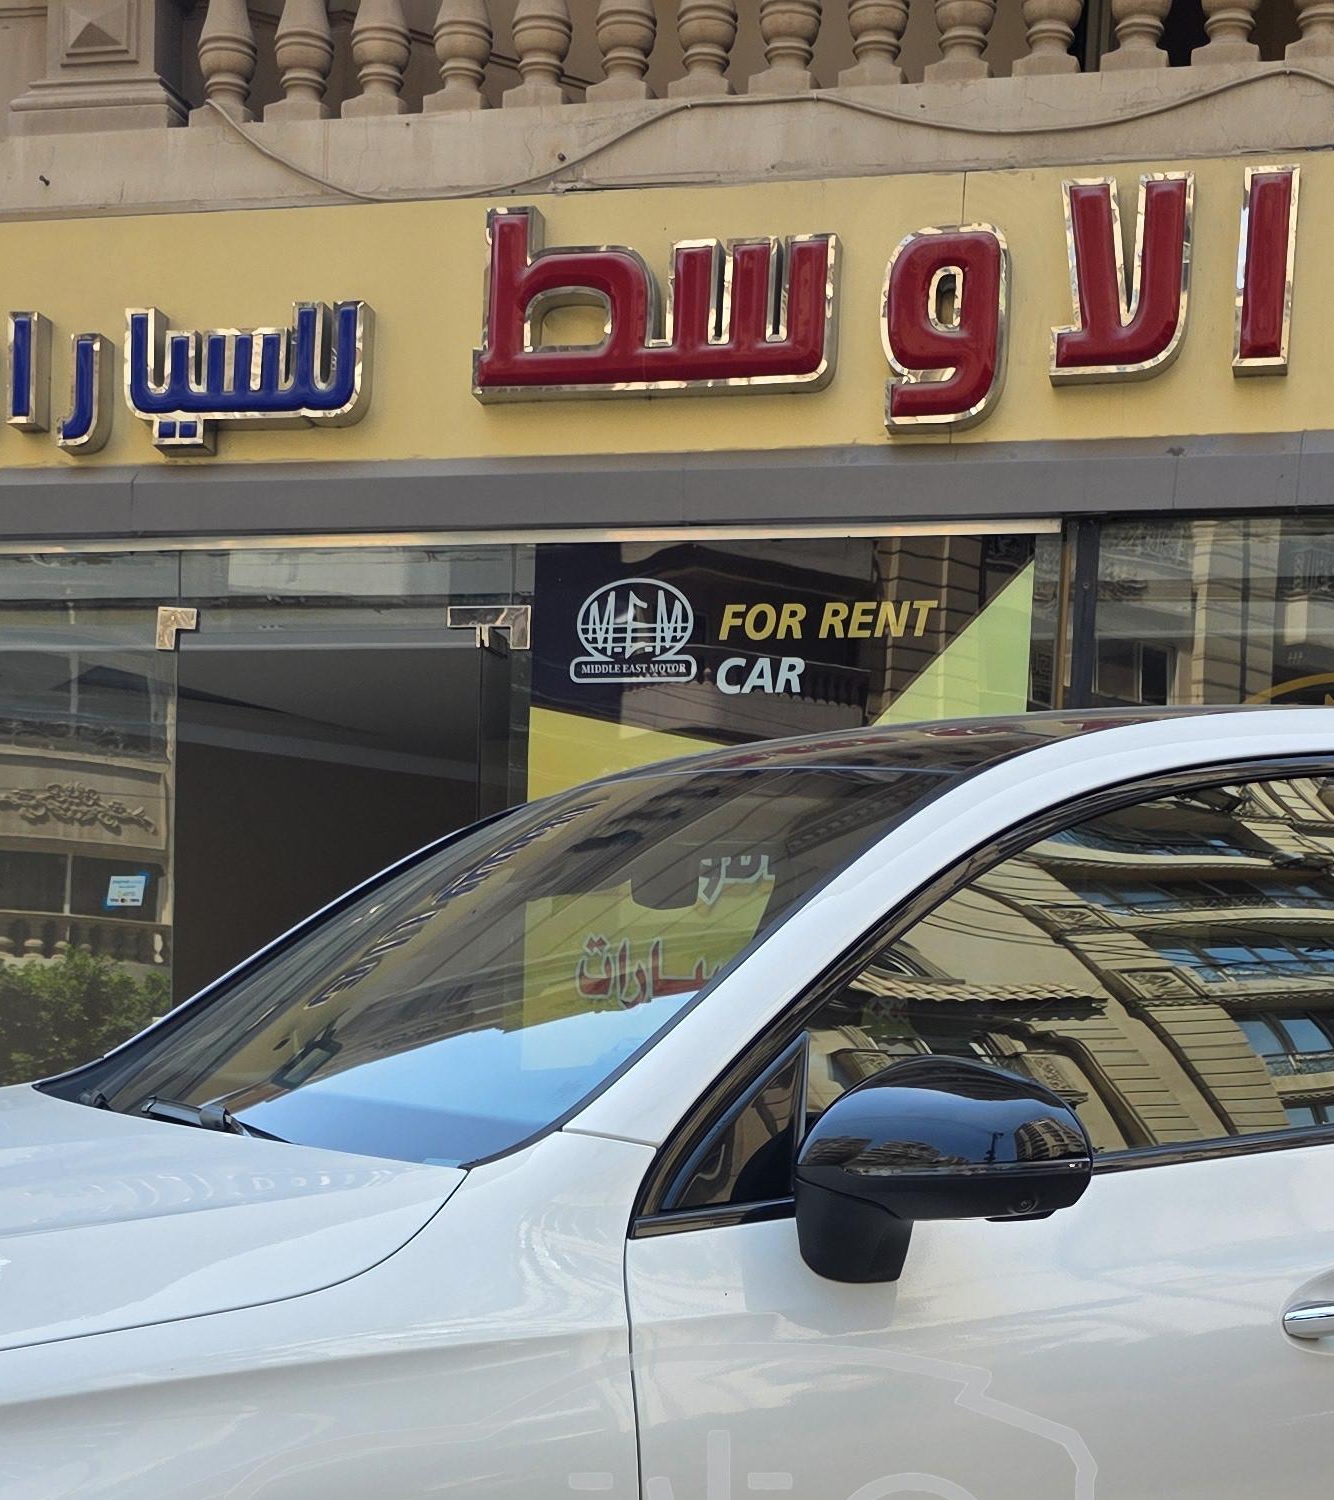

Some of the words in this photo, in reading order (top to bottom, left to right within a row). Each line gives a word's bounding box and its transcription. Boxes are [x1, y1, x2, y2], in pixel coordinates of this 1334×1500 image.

[472, 163, 1302, 434] الاوسط
[718, 603, 807, 641] FOR
[818, 599, 939, 639] RENT
[581, 664, 621, 674] MIDDLE
[622, 663, 648, 673] EAST
[649, 662, 687, 673] MOTOR
[715, 656, 806, 695] CAR
